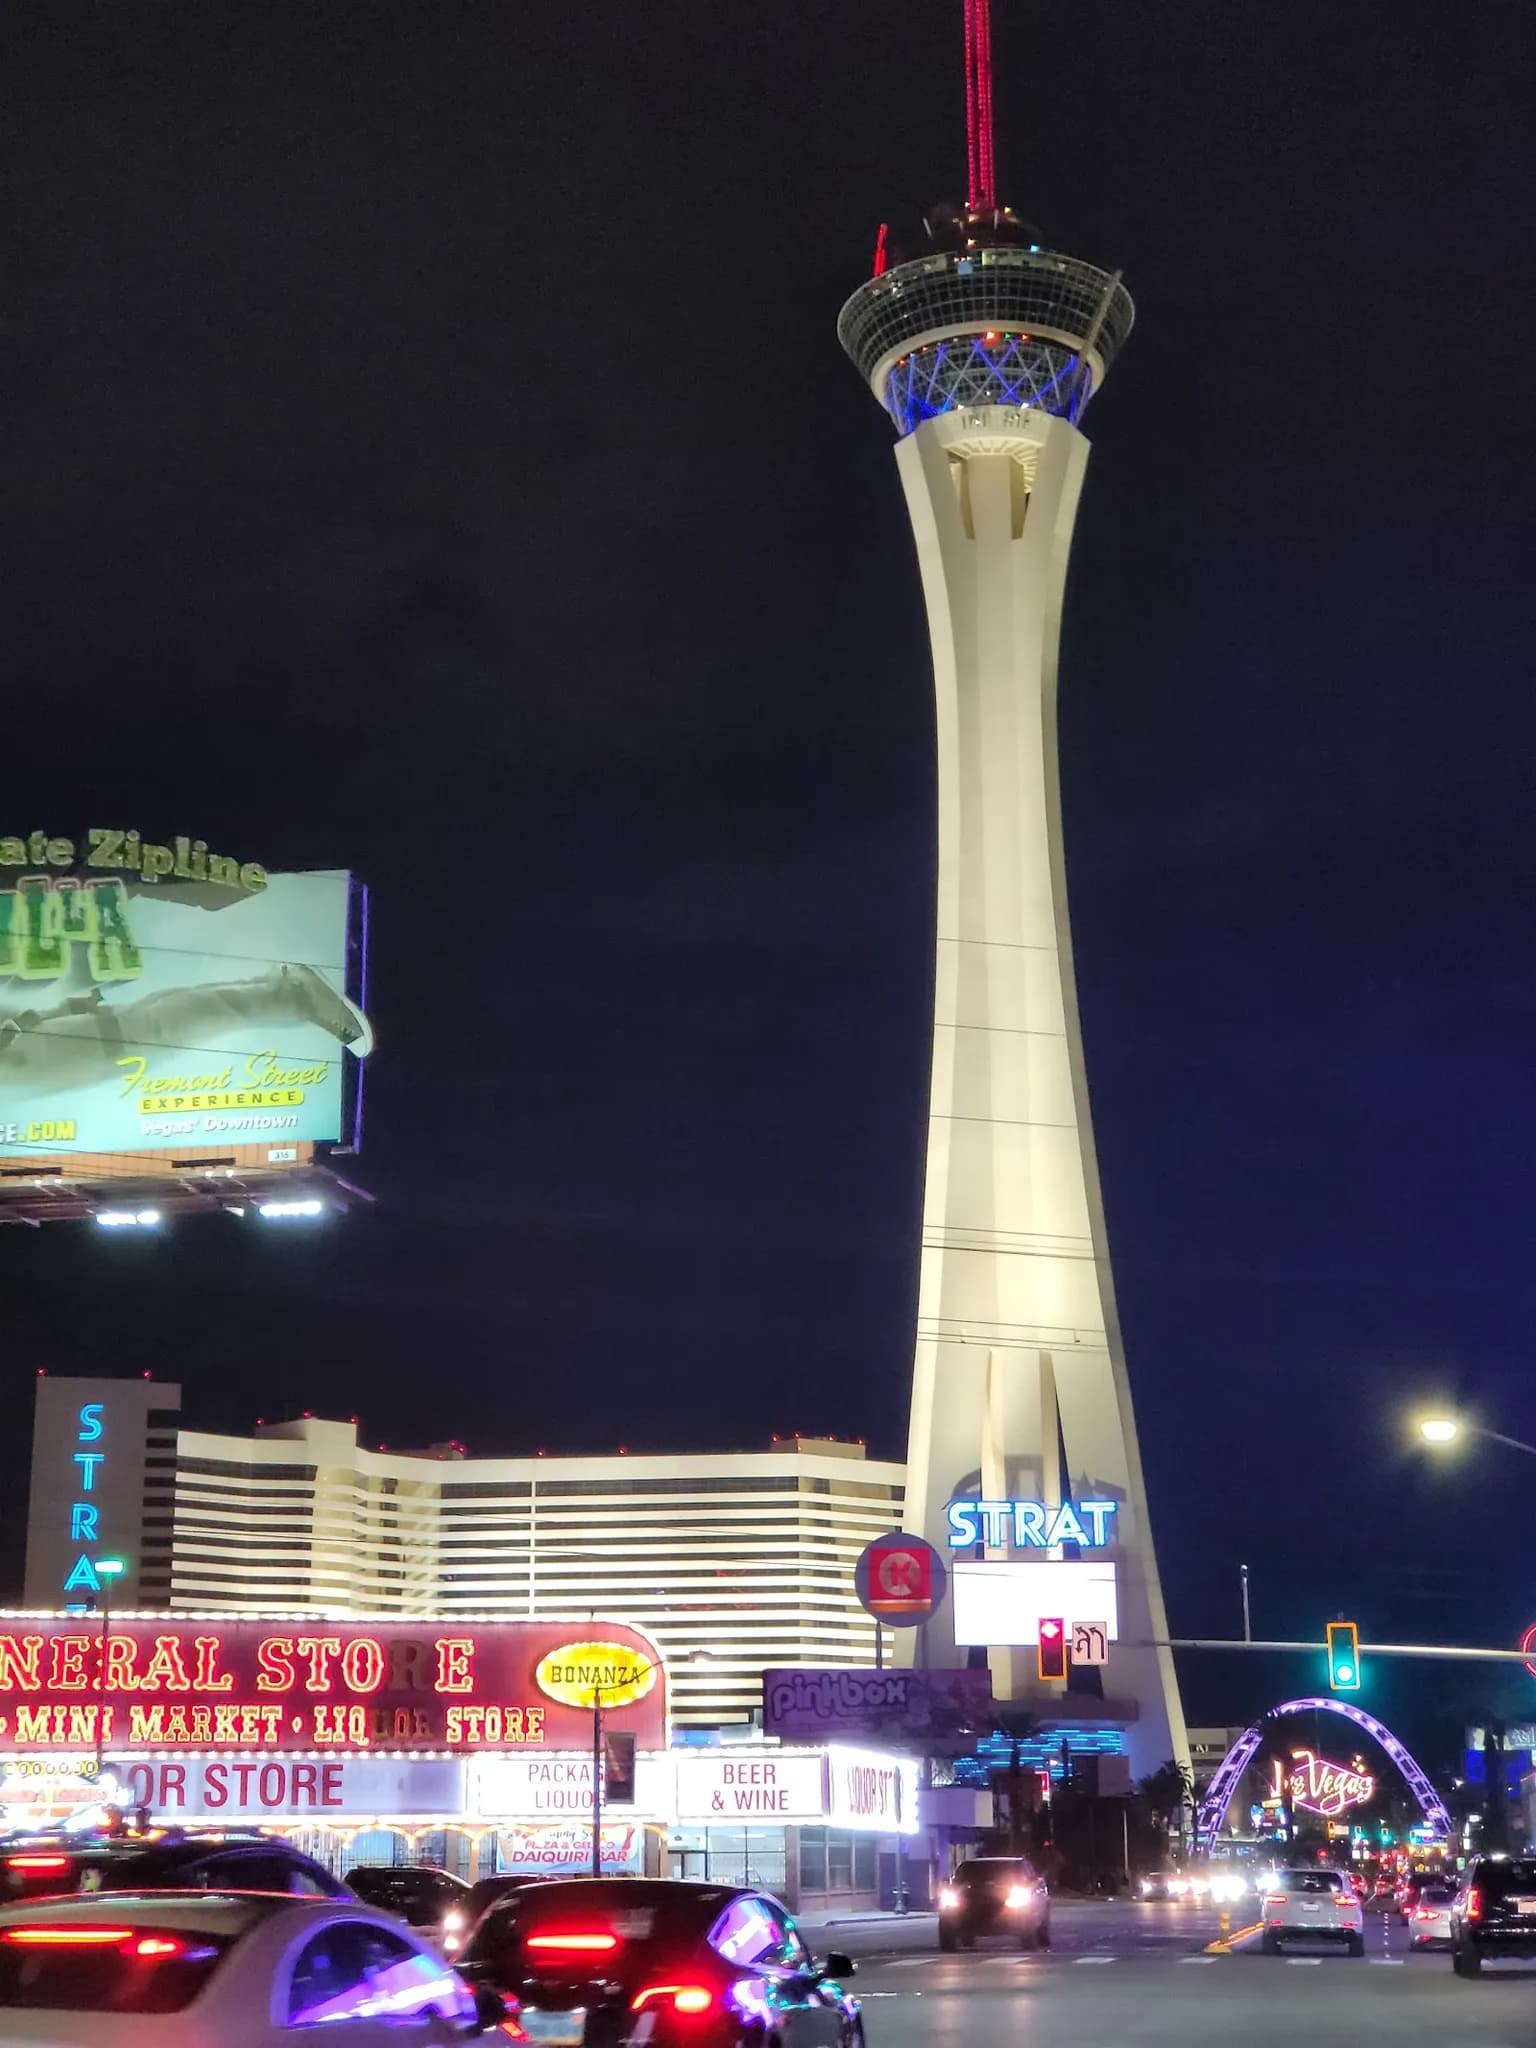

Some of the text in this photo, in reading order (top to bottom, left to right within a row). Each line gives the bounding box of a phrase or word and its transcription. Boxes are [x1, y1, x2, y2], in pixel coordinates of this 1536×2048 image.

[88, 828, 268, 892] Zipline
[116, 1049, 328, 1097] Fremont Street
[143, 1091, 296, 1110] EXPERIENCE
[203, 1115, 298, 1132] Downtown
[949, 1501, 1117, 1547] STRAT
[0, 1636, 474, 1693] NERAL STORE
[552, 1666, 640, 1684] BONANZA
[772, 1673, 906, 1720] pinkbox
[15, 1705, 114, 1743] MINI
[129, 1705, 283, 1743] MARKET
[446, 1706, 545, 1743] STORE
[204, 1763, 343, 1807] STORE
[723, 1764, 776, 1784] BEER
[1291, 1751, 1373, 1815] Vegas
[711, 1790, 789, 1810] & WINE
[512, 1851, 589, 1863] DAIQUIRI
